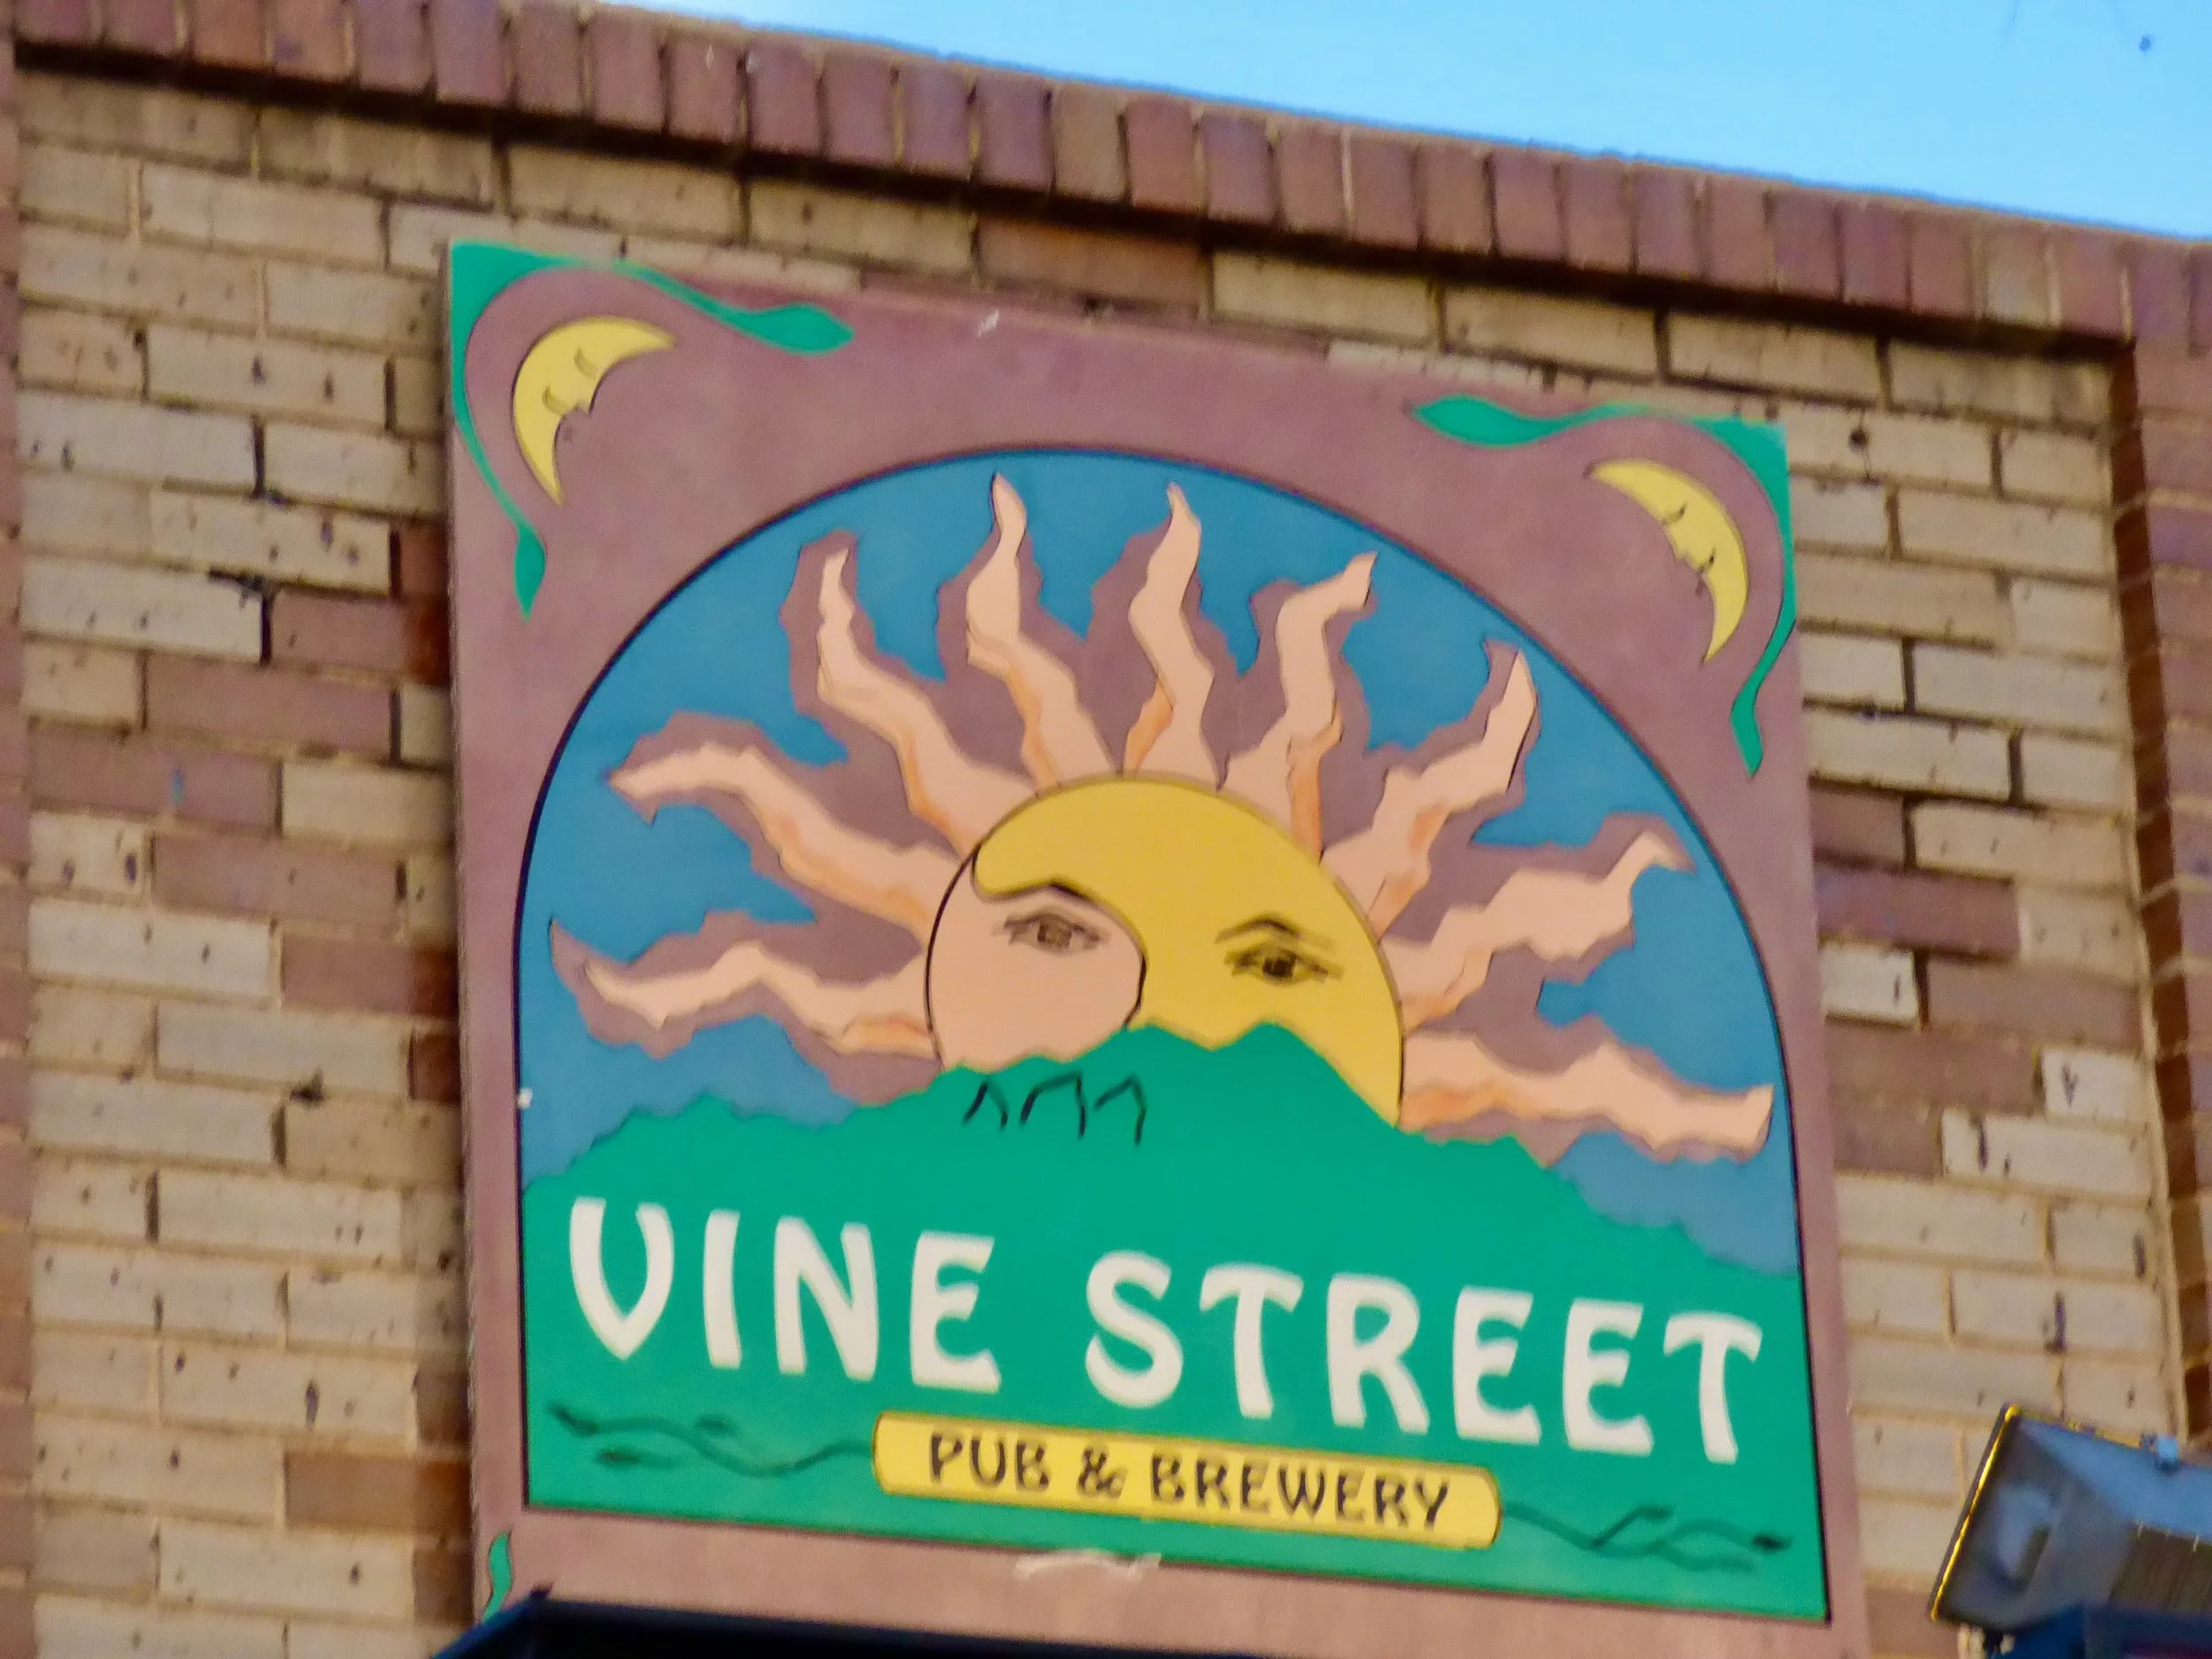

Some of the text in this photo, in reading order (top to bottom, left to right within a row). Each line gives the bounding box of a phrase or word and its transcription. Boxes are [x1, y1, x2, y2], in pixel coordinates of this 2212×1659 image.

[569, 1199, 1763, 1463] VINE STREET
[928, 1432, 1451, 1532] PUB & BREWERY
